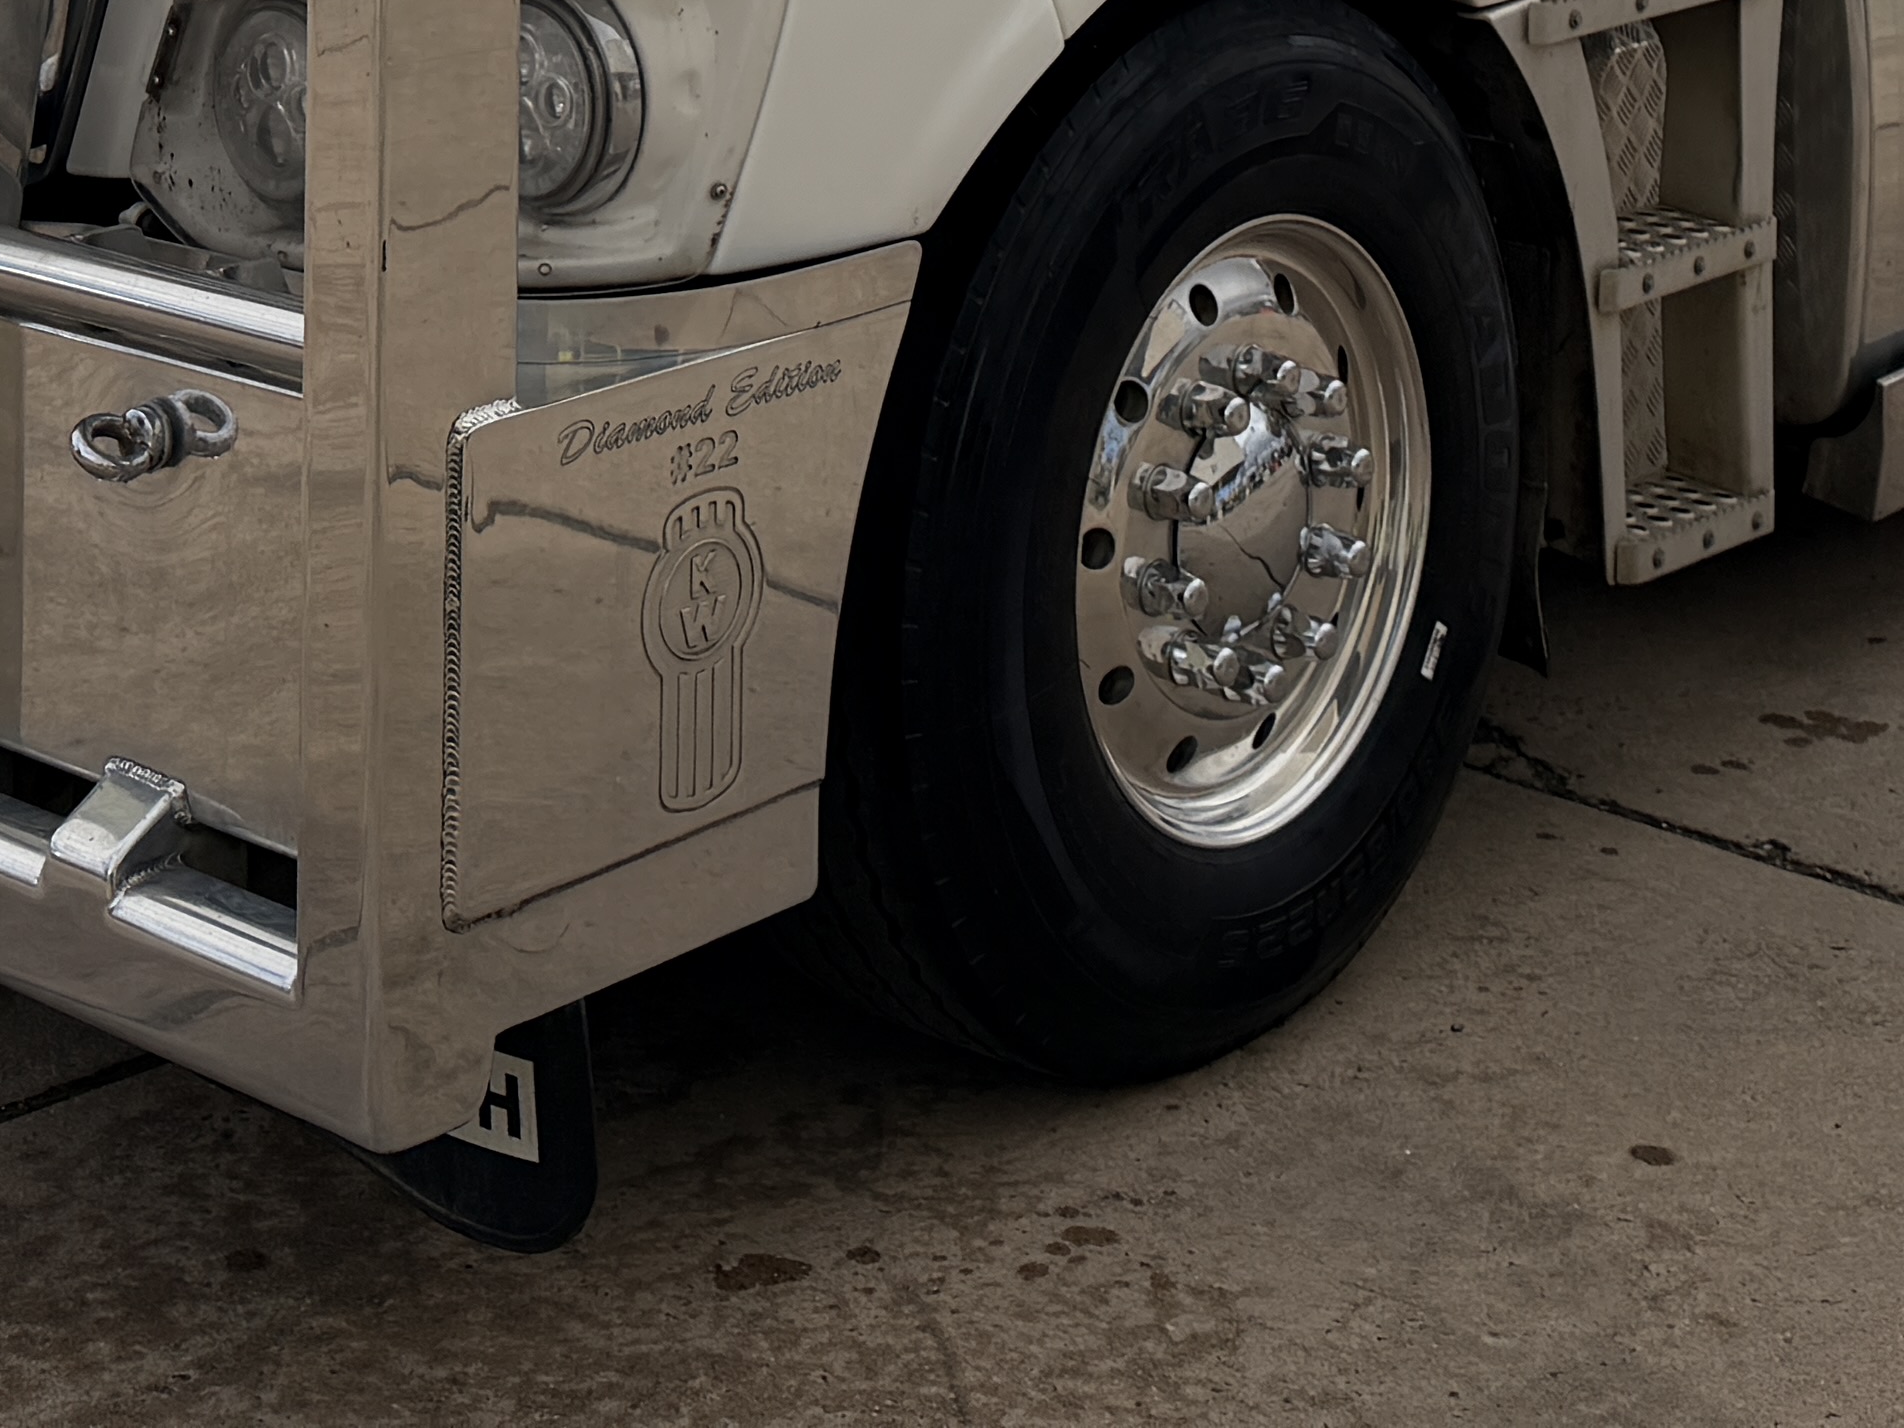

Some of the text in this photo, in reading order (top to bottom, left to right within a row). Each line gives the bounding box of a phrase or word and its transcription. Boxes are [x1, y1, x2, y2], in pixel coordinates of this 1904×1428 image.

[557, 355, 842, 468] Diamond Edition
[669, 429, 740, 487] #22
